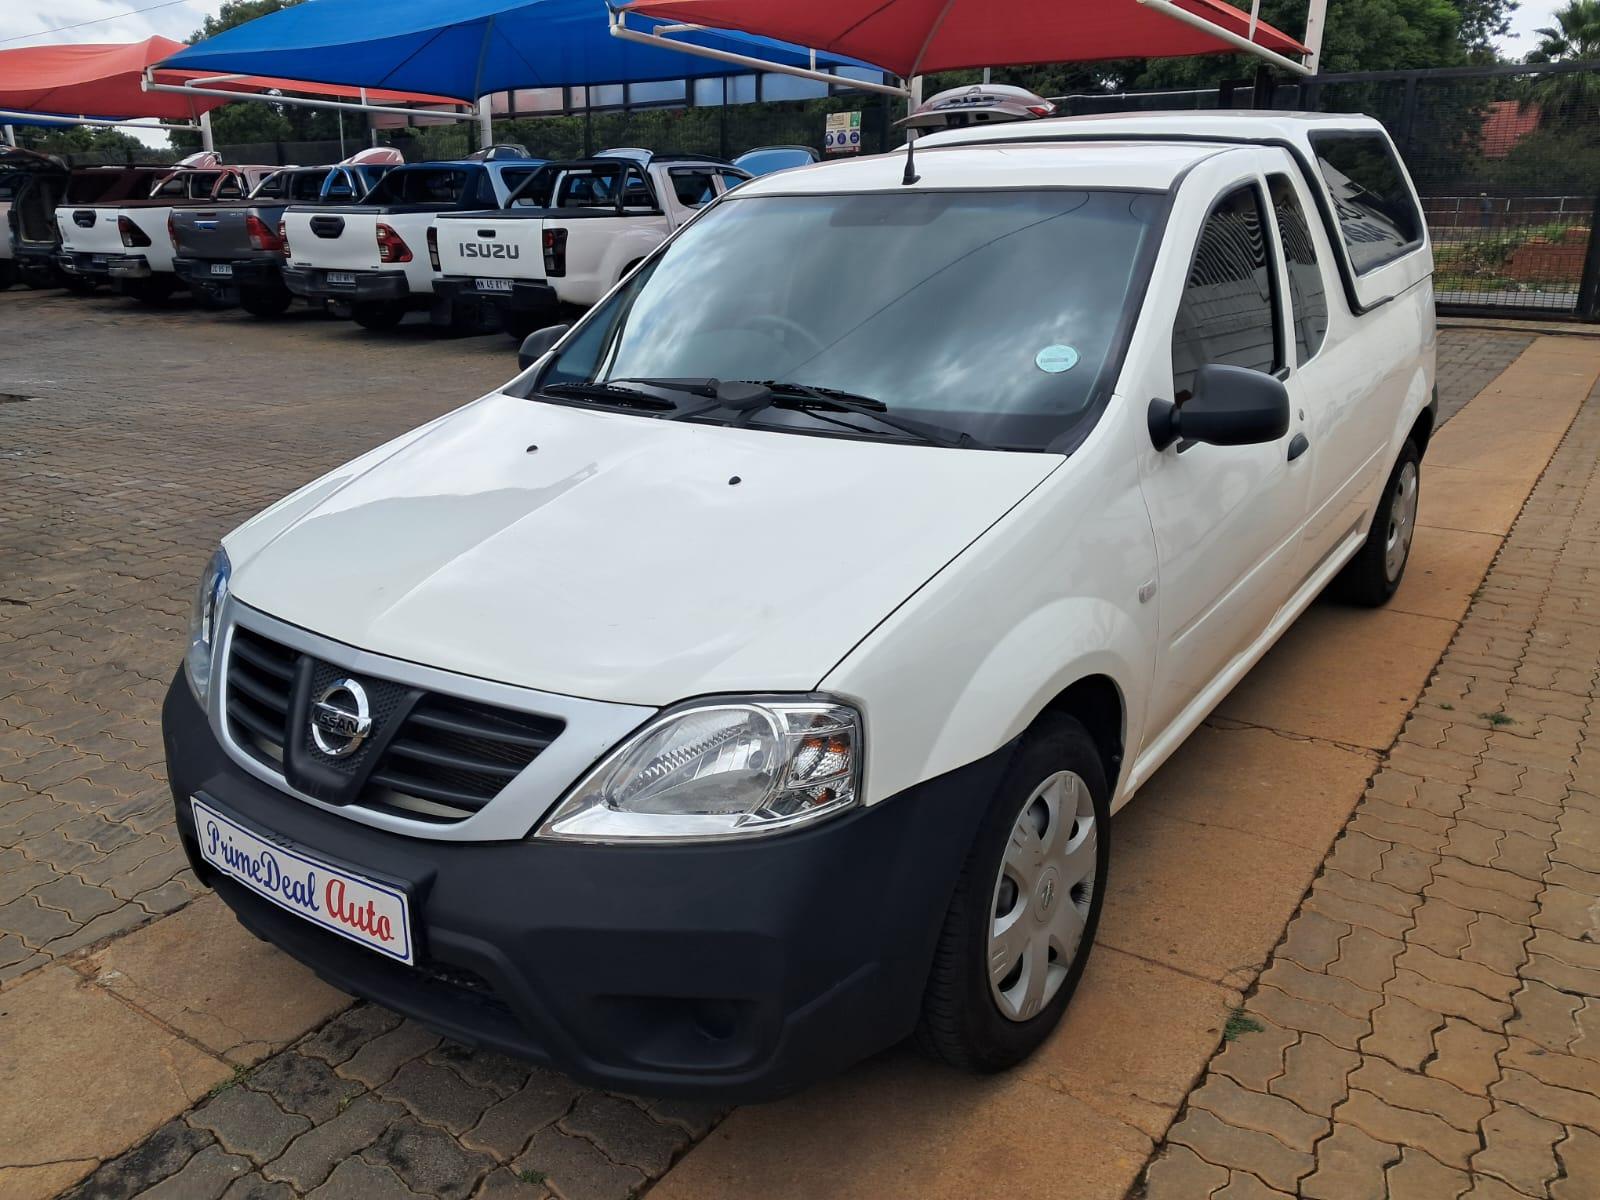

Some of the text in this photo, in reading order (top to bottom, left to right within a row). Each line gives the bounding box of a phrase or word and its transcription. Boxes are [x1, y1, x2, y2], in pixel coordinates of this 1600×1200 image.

[459, 242, 520, 260] ISUZU
[313, 707, 360, 734] NISSAN
[206, 820, 395, 942] PrimeDeal Auto
